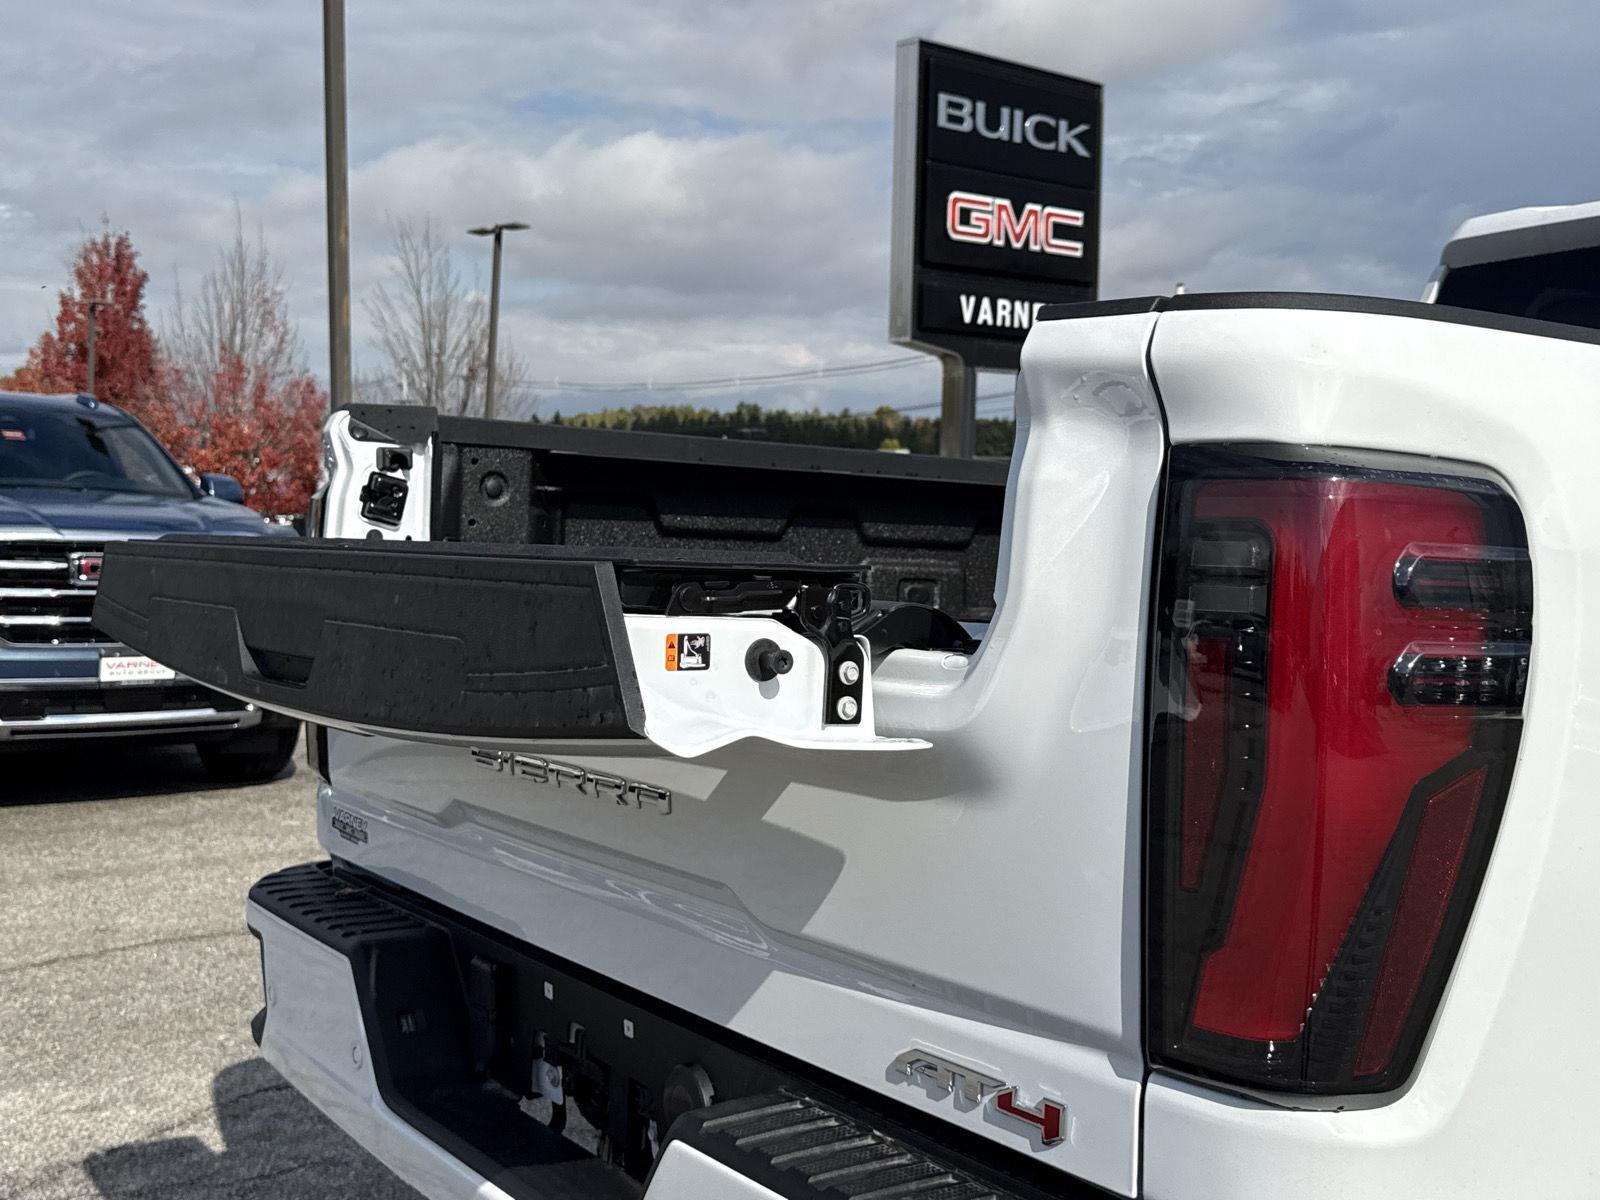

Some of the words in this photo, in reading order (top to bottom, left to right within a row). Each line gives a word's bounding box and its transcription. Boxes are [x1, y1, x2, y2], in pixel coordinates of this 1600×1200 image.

[937, 92, 1091, 158] BUICK
[947, 190, 1085, 258] GMC
[895, 1048, 1067, 1145] AT4
